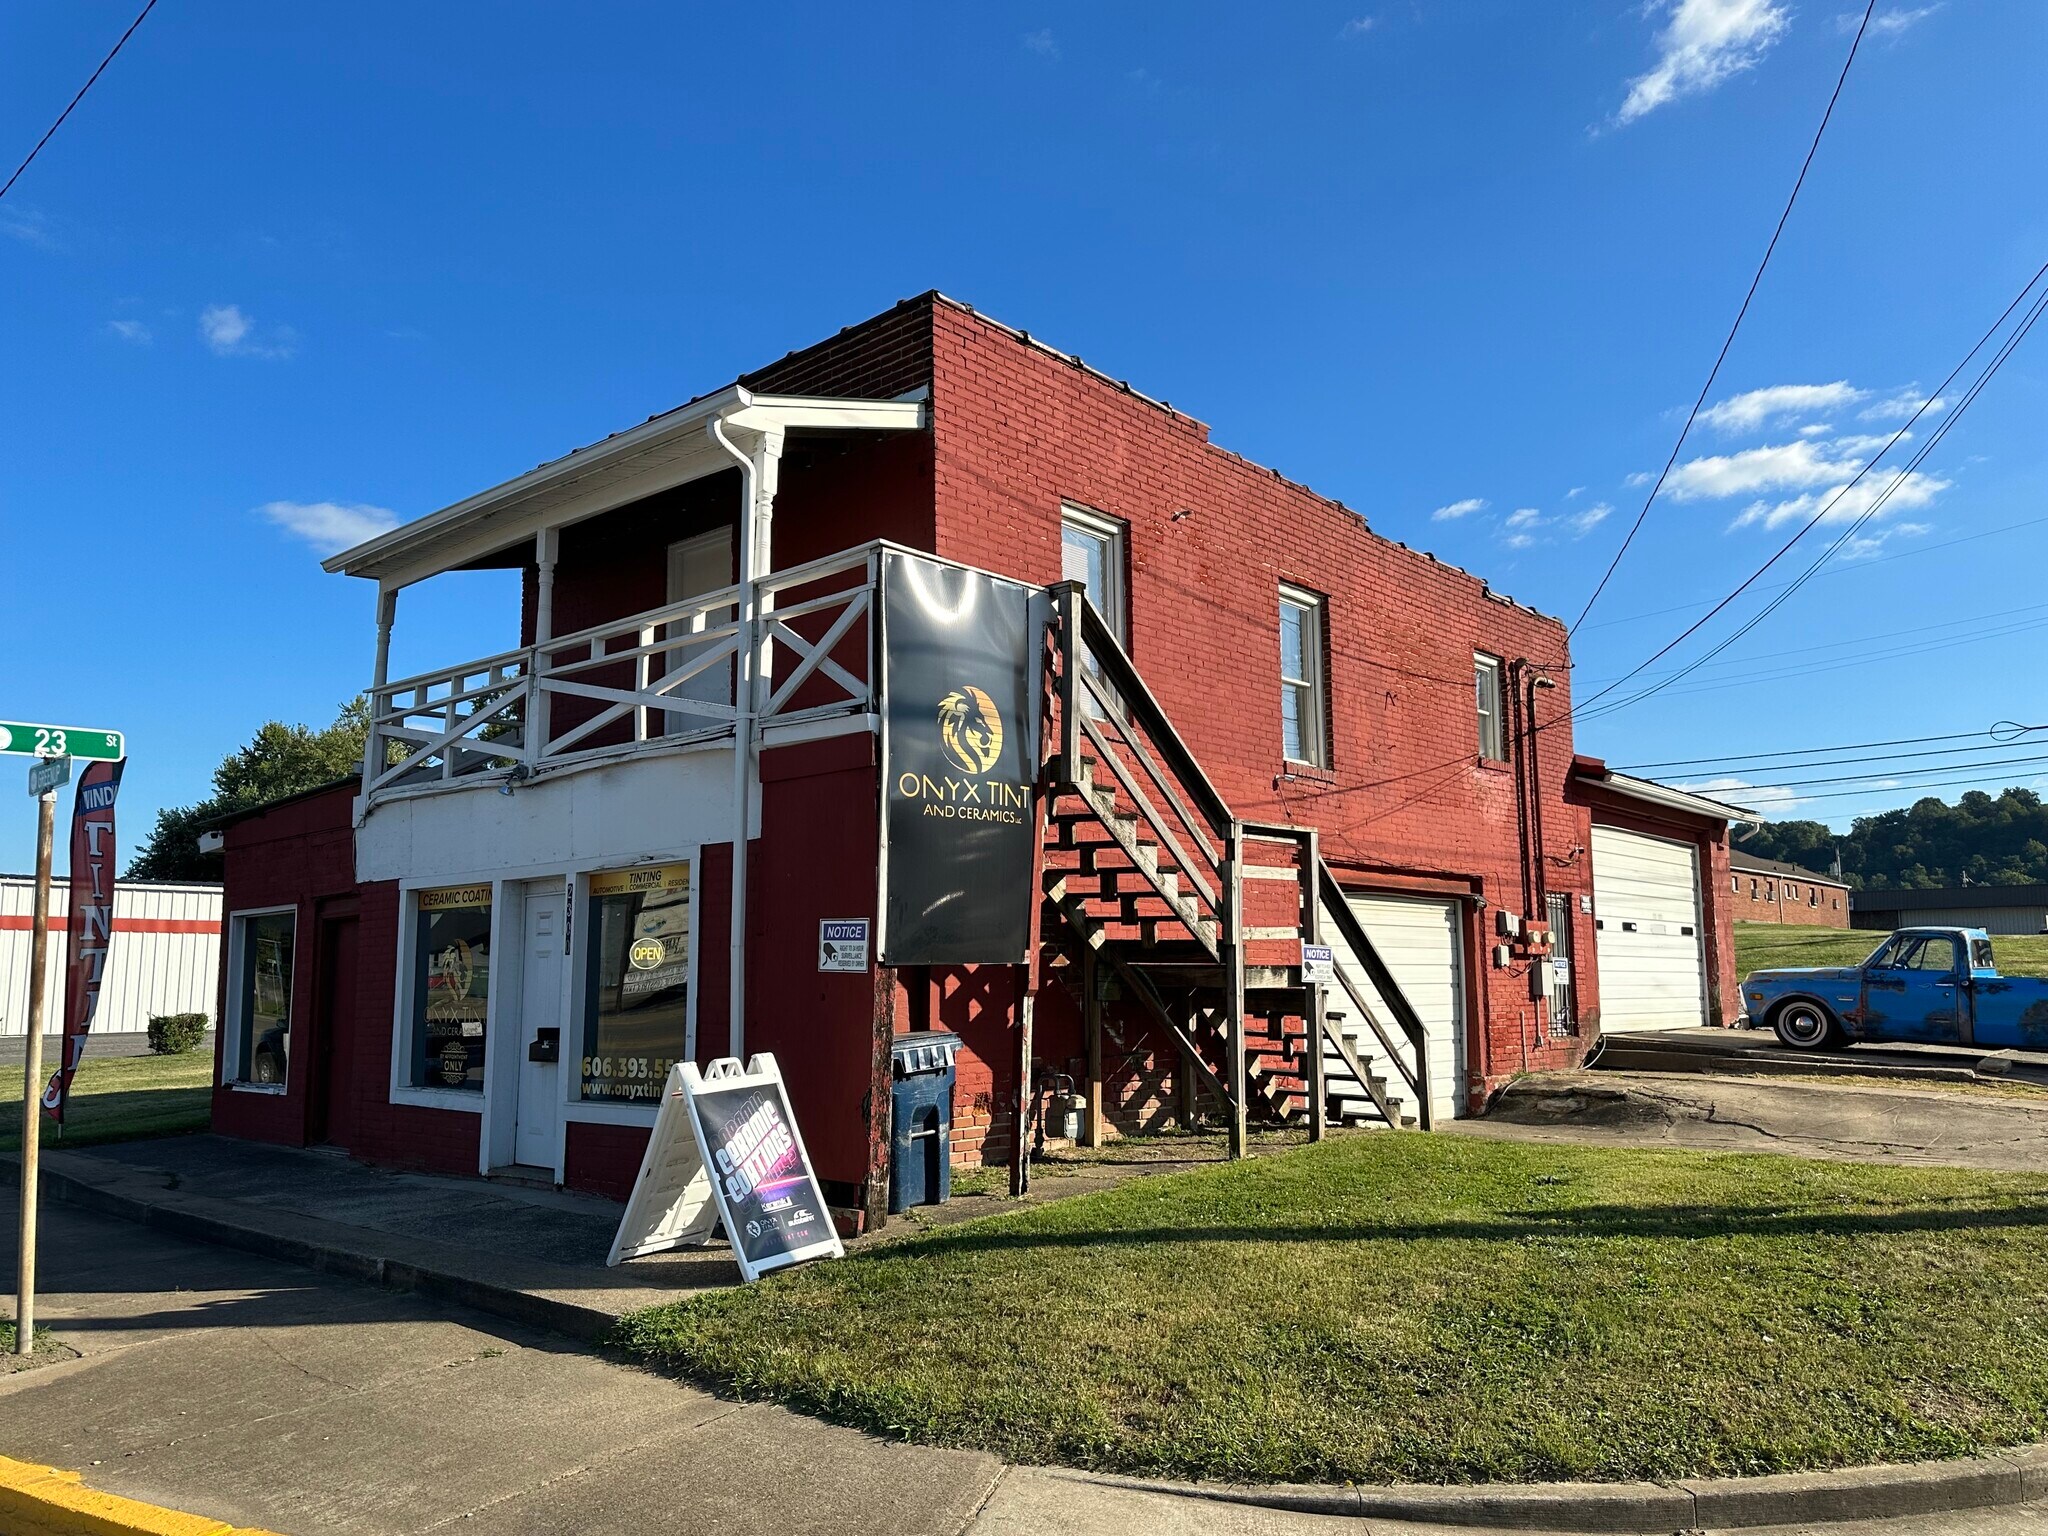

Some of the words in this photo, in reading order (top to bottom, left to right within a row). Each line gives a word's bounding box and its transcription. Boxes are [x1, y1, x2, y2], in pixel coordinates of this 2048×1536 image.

[34, 728, 67, 756] 23
[105, 734, 118, 747] St
[899, 772, 981, 804] ONYX
[986, 781, 1030, 809] TINT
[923, 803, 956, 818] AND
[958, 806, 1015, 824] CERAMICS
[629, 870, 662, 884] TINTING
[592, 884, 624, 895] AUTOMOTIVE
[629, 881, 662, 891] COMMERCIAL
[423, 891, 460, 906] CERAMIC
[827, 926, 862, 938] NOTICE
[634, 947, 661, 961] OPEN
[1306, 949, 1330, 960] NOTICE
[444, 1060, 463, 1072] ONLY
[582, 1056, 684, 1079] 606.393.55
[715, 1100, 780, 1175] CERAMIC
[725, 1122, 792, 1203] COATINGS
